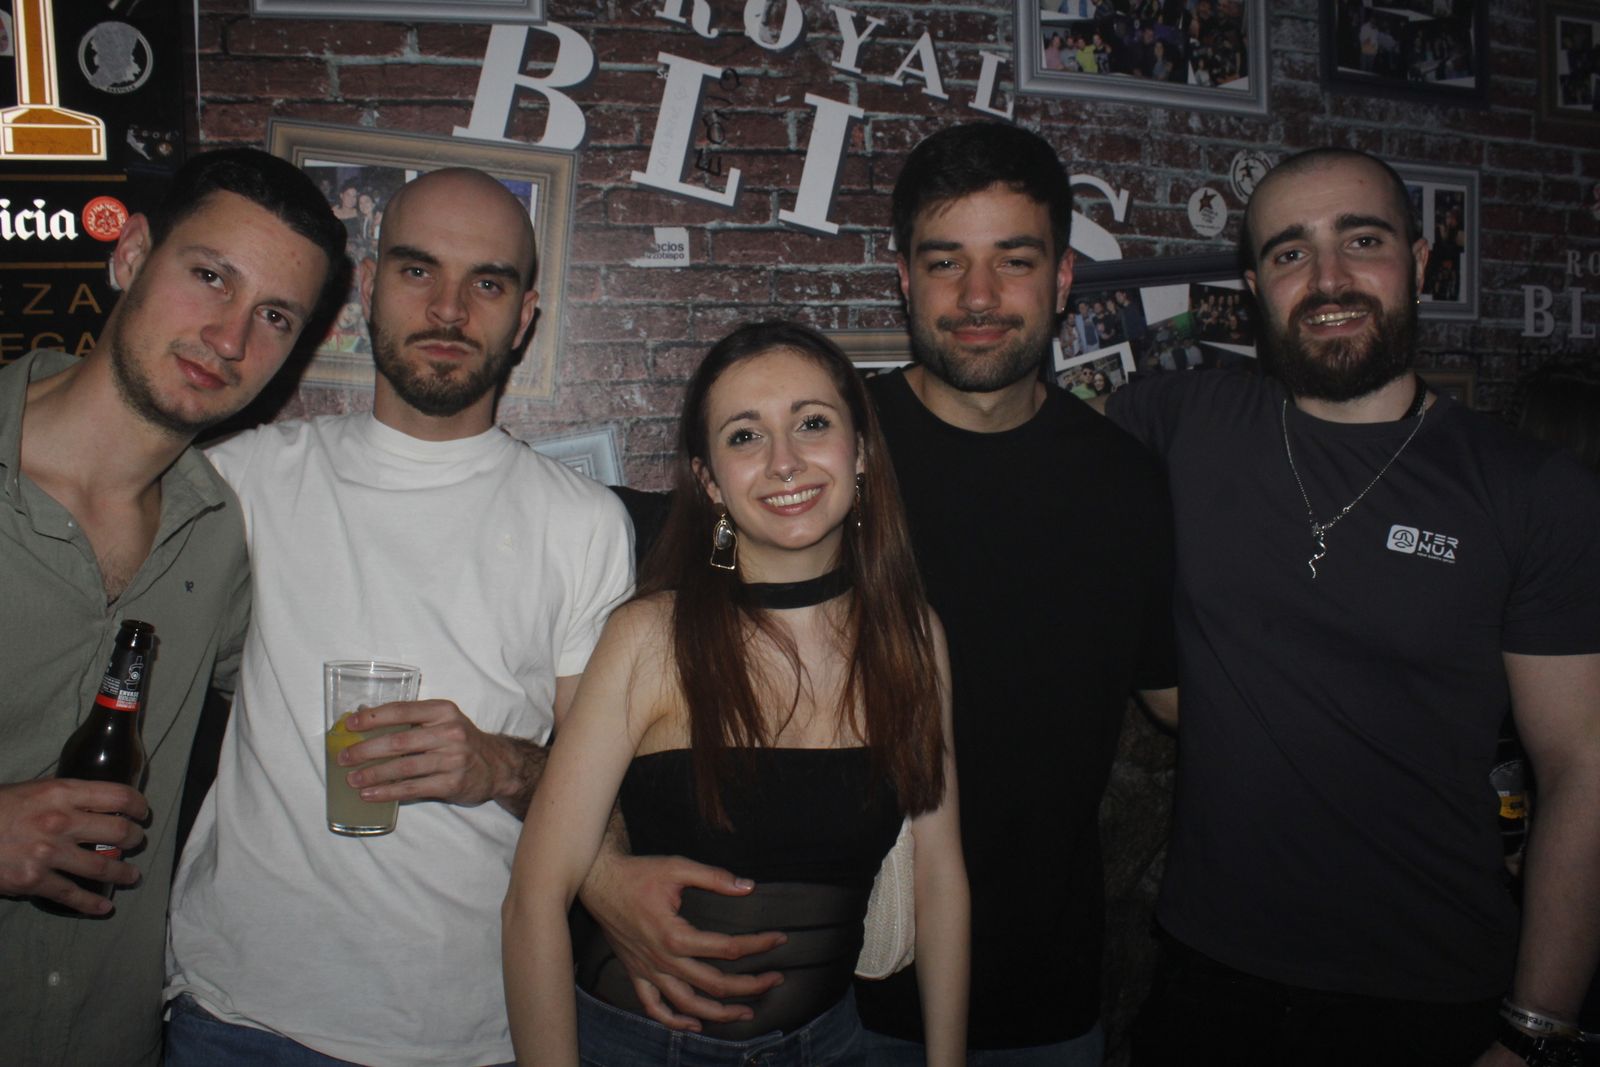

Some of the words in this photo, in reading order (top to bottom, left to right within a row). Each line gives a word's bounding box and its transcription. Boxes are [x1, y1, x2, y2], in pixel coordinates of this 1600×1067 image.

[452, 22, 1129, 262] BLI
[0, 283, 102, 315] ZA
[1520, 284, 1596, 339] BL
[1417, 541, 1456, 560] NUA
[1422, 530, 1459, 549] TER
